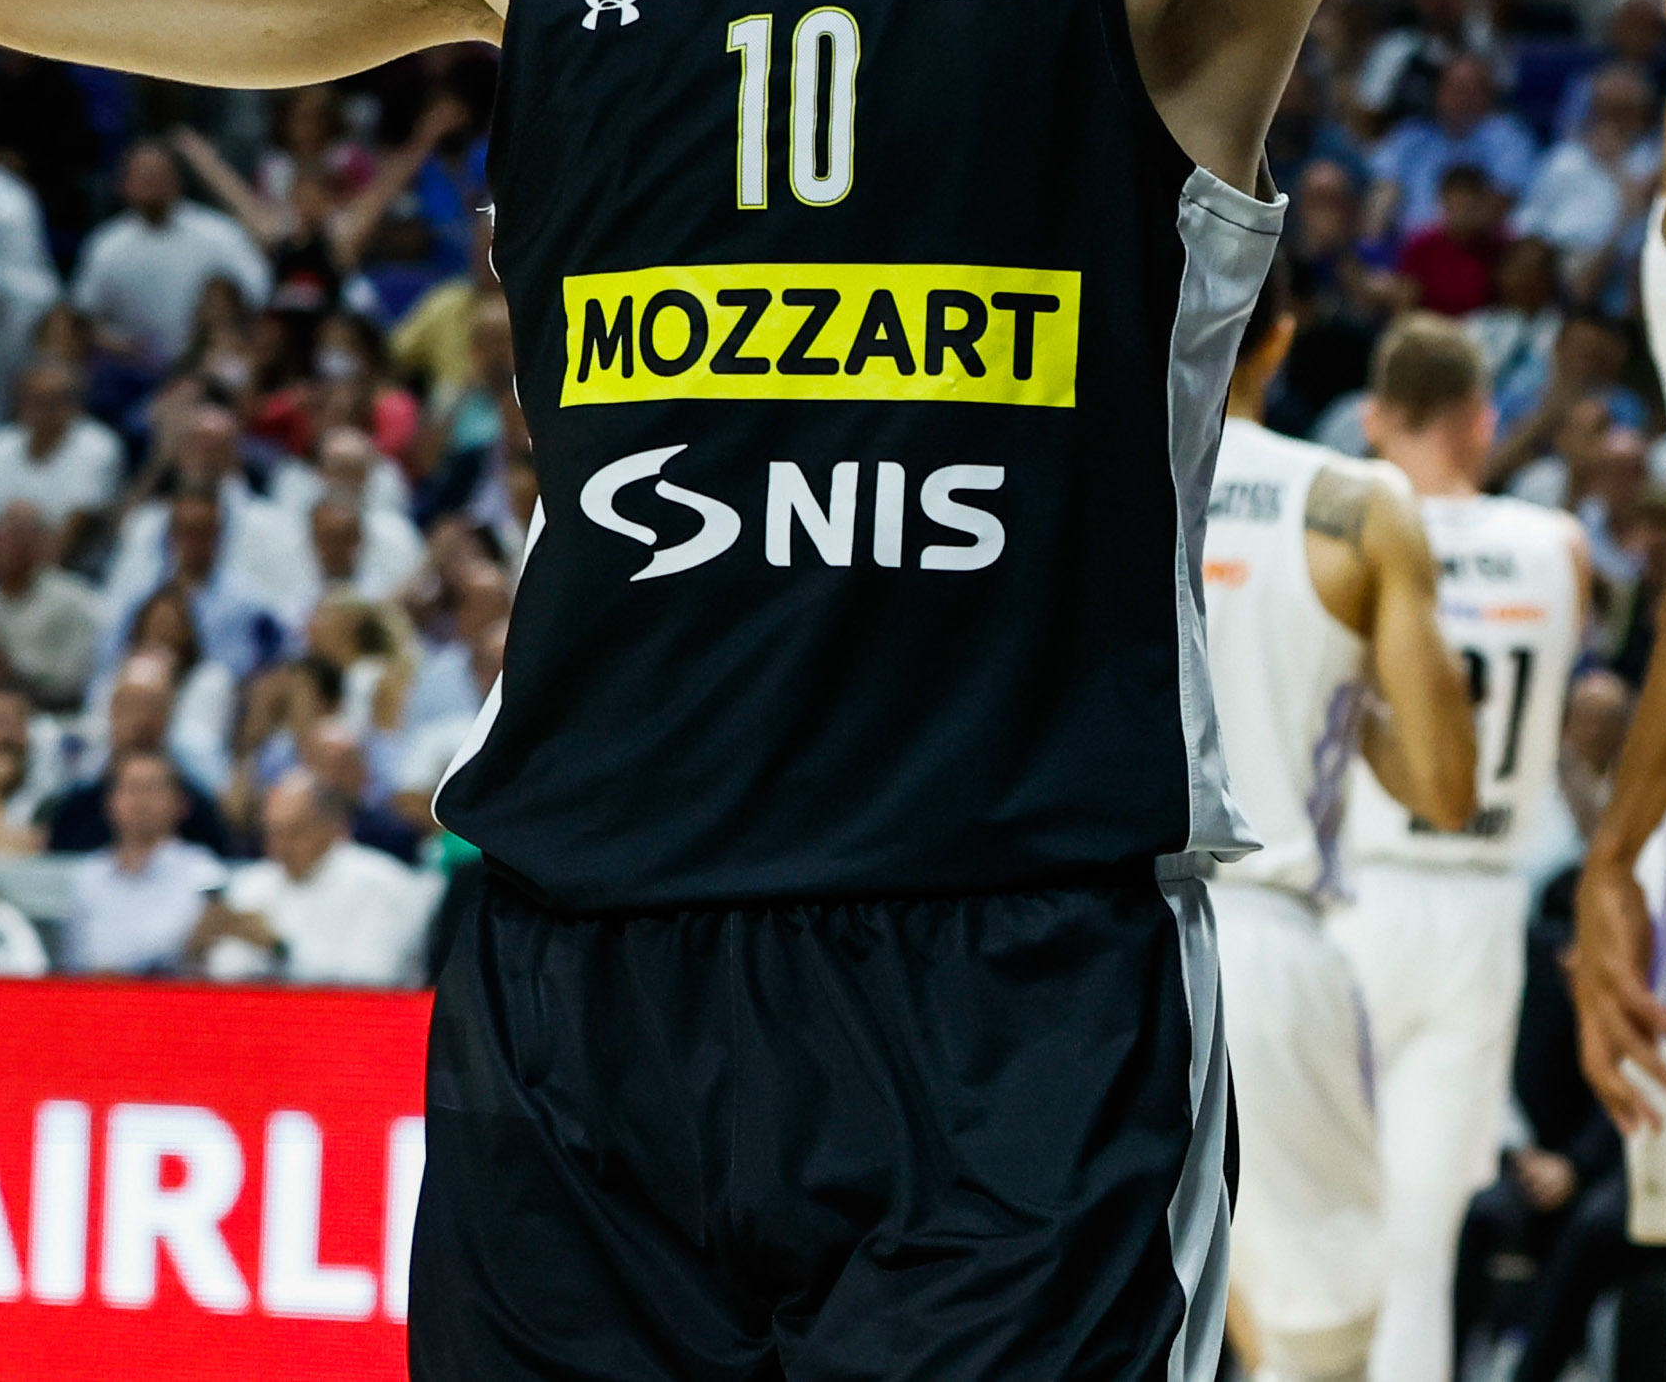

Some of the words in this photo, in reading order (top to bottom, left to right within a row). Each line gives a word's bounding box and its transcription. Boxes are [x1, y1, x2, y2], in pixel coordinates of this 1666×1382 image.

[726, 6, 860, 210] 10
[577, 288, 1060, 383] MOZZART
[765, 461, 1005, 571] NIS
